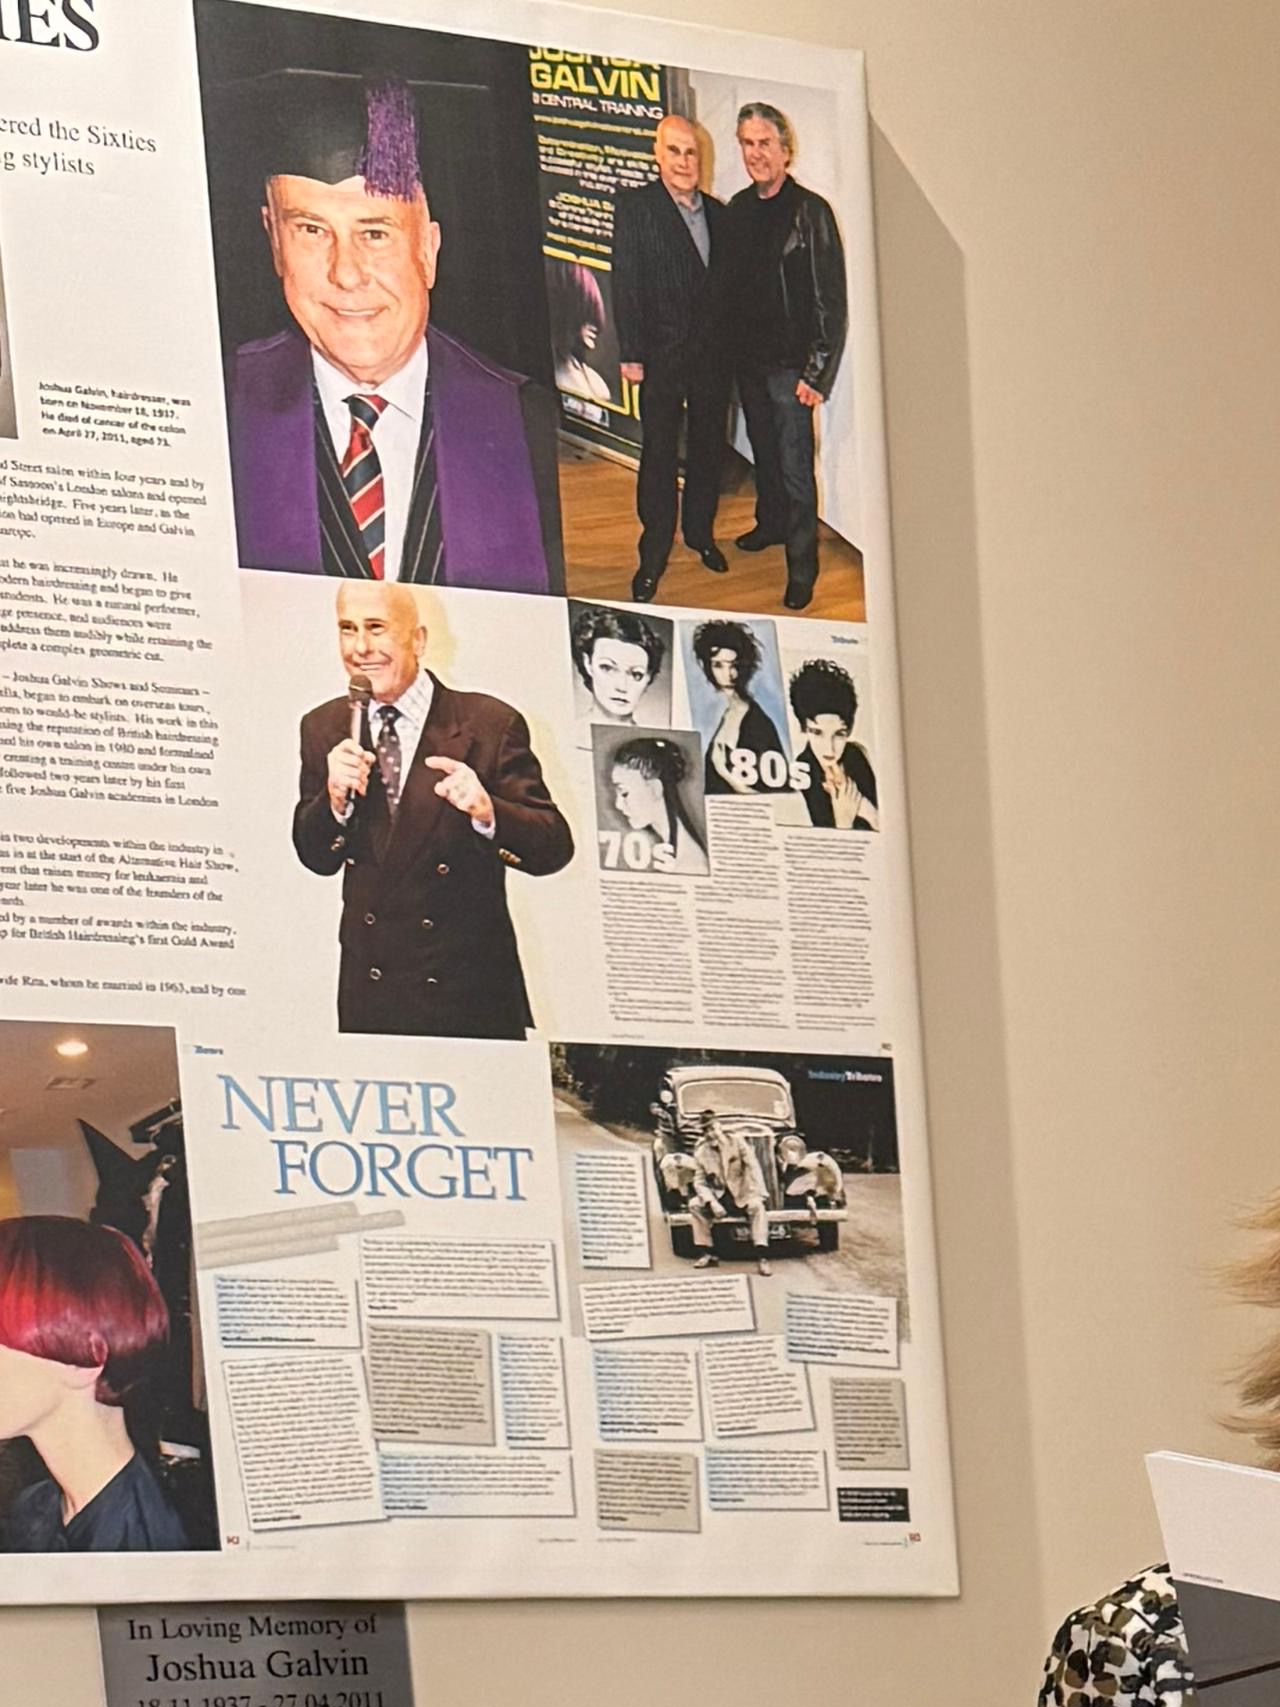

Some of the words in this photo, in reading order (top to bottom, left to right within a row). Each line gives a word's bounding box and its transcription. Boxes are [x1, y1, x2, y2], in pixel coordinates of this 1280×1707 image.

[0, 0, 99, 51] ES
[530, 62, 661, 102] GALVIN
[601, 99, 664, 120] TRAINING
[49, 120, 80, 141] the
[88, 125, 157, 152] Sixties
[0, 151, 16, 171] g
[22, 152, 96, 176] stylists
[728, 747, 812, 791] 80s
[598, 829, 676, 873] 70s
[216, 1074, 466, 1137] NEVER
[270, 1139, 534, 1201] FORGET
[127, 1619, 152, 1640] In
[161, 1616, 243, 1643] Loving
[248, 1615, 347, 1640] Memory
[354, 1613, 378, 1634] of
[146, 1652, 256, 1683] Joshua
[266, 1649, 369, 1678] Galvin
